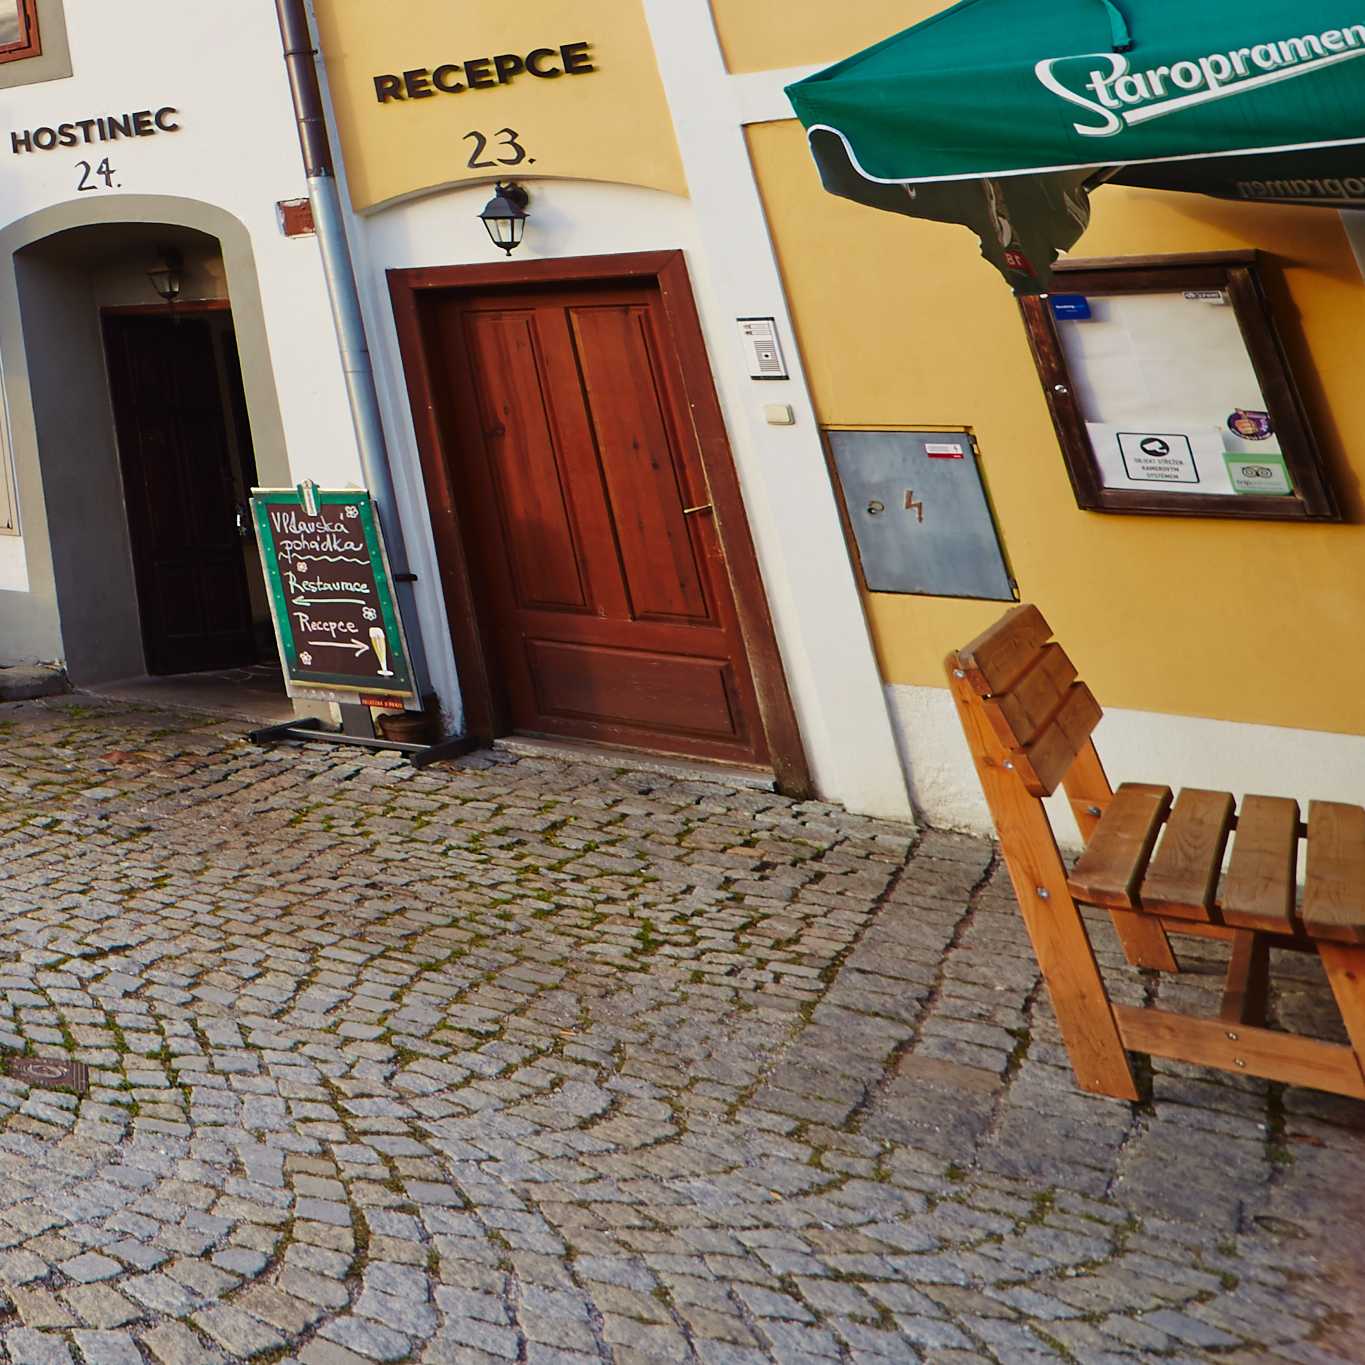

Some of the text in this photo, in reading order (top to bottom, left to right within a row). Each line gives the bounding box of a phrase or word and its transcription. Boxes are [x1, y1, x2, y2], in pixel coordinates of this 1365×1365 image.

[373, 42, 594, 103] RECEPCE
[1035, 23, 1365, 136] Staropramen
[10, 106, 180, 154] HOSTINEC
[279, 533, 364, 564] pohádka
[283, 571, 370, 594] Restaurace
[293, 612, 359, 638] Recepce
